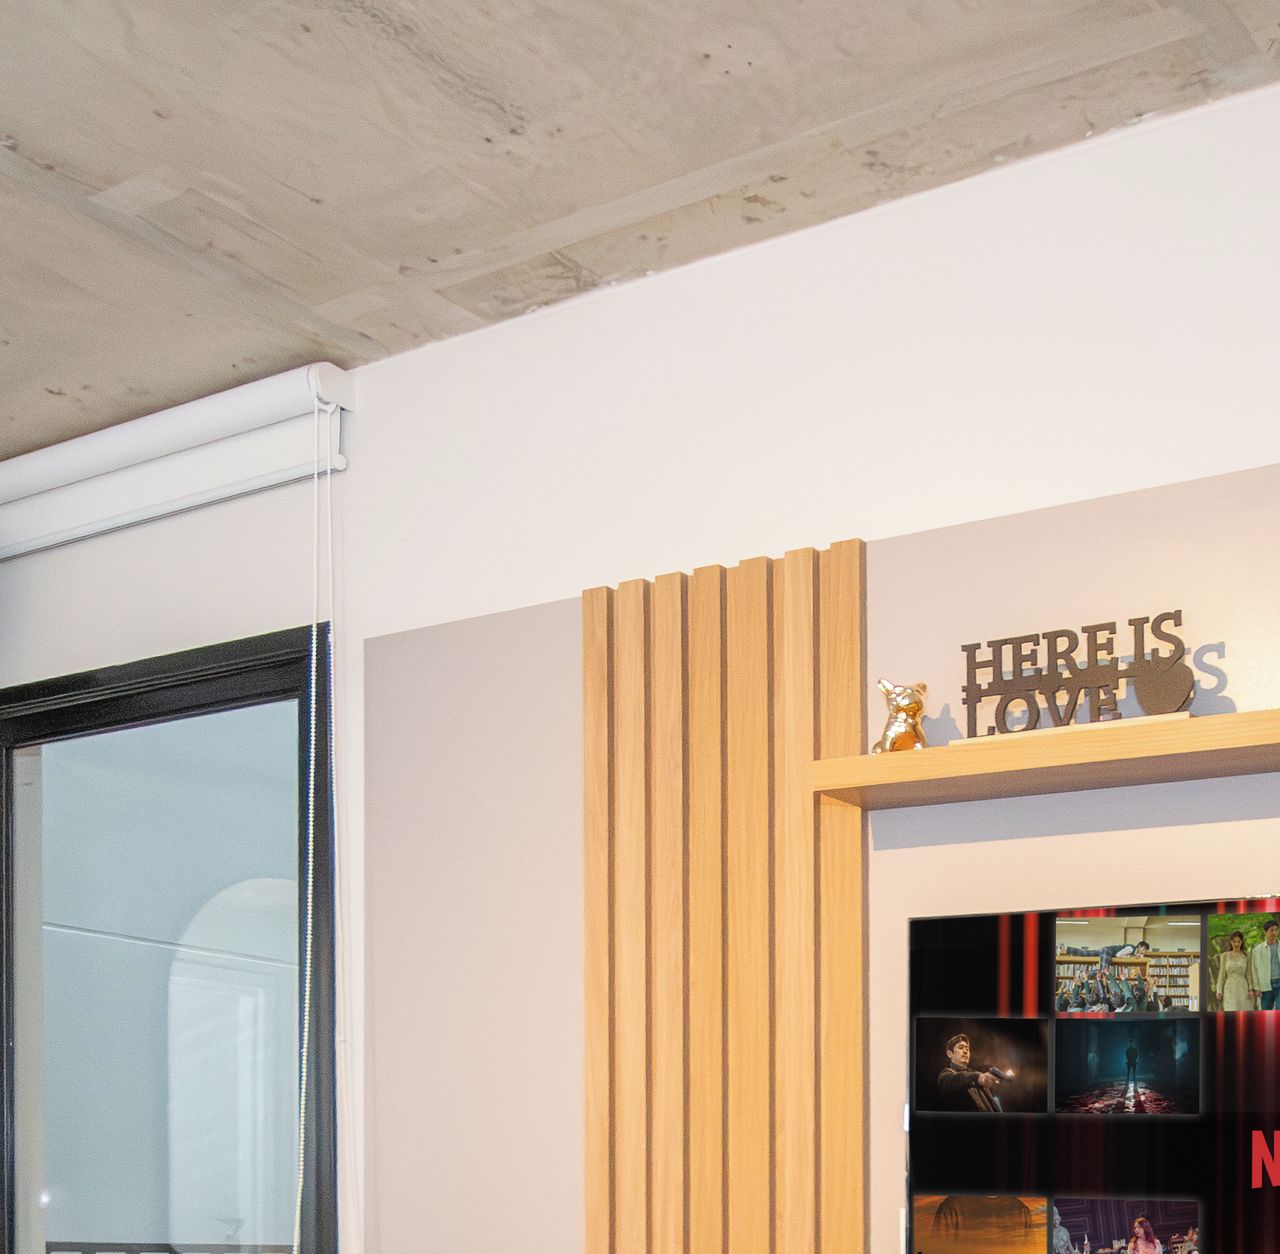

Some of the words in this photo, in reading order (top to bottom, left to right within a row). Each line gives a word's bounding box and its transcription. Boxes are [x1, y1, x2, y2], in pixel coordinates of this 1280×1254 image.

[961, 622, 1117, 690] HERE
[1128, 609, 1185, 665] IS
[963, 684, 1122, 738] LOVE
